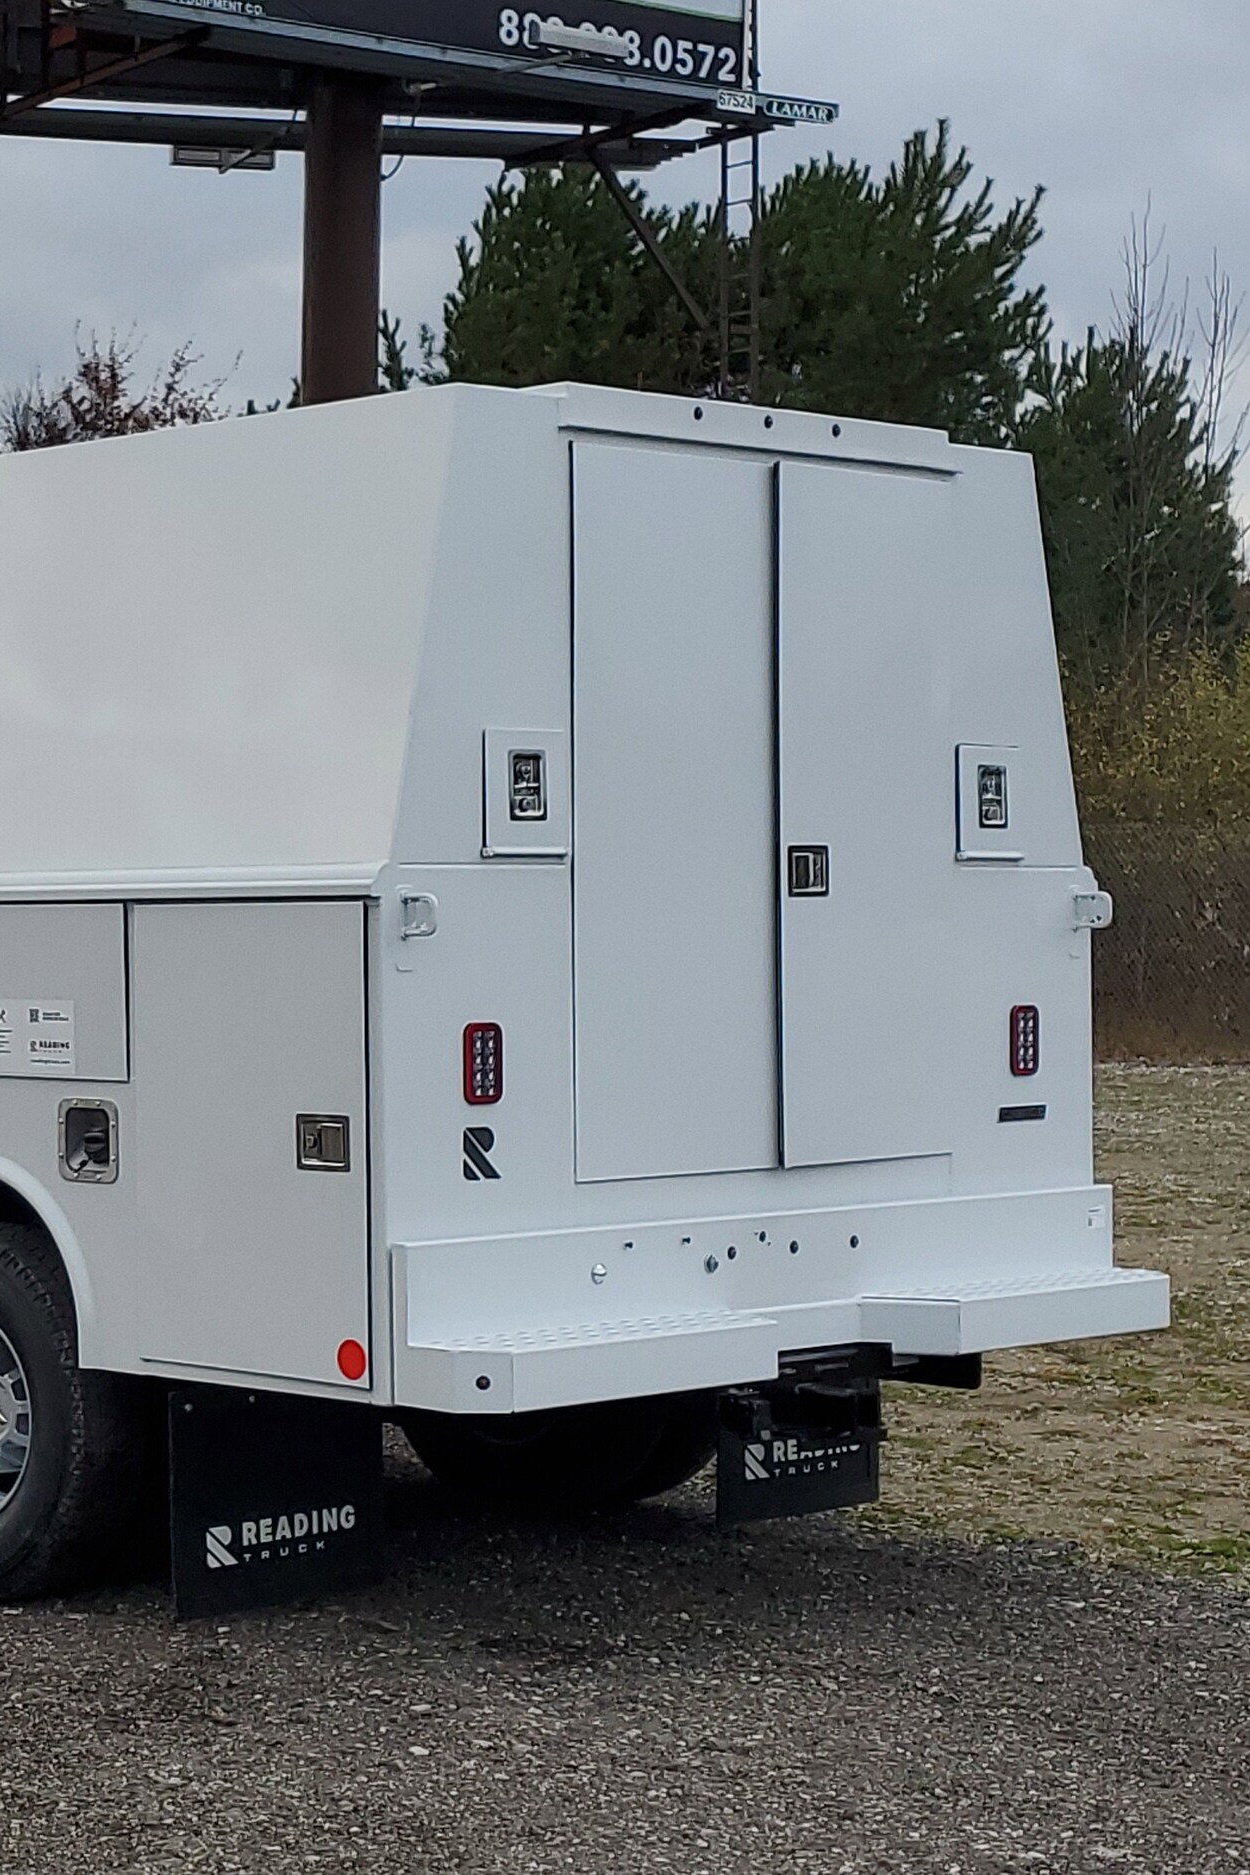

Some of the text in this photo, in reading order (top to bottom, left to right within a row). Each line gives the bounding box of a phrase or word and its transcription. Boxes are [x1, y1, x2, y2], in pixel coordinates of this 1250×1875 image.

[719, 91, 753, 110] 67524
[771, 101, 829, 121] LAMAR
[774, 1460, 839, 1478] TRUCK
[242, 1504, 356, 1547] READING
[243, 1540, 326, 1563] TRUCK
